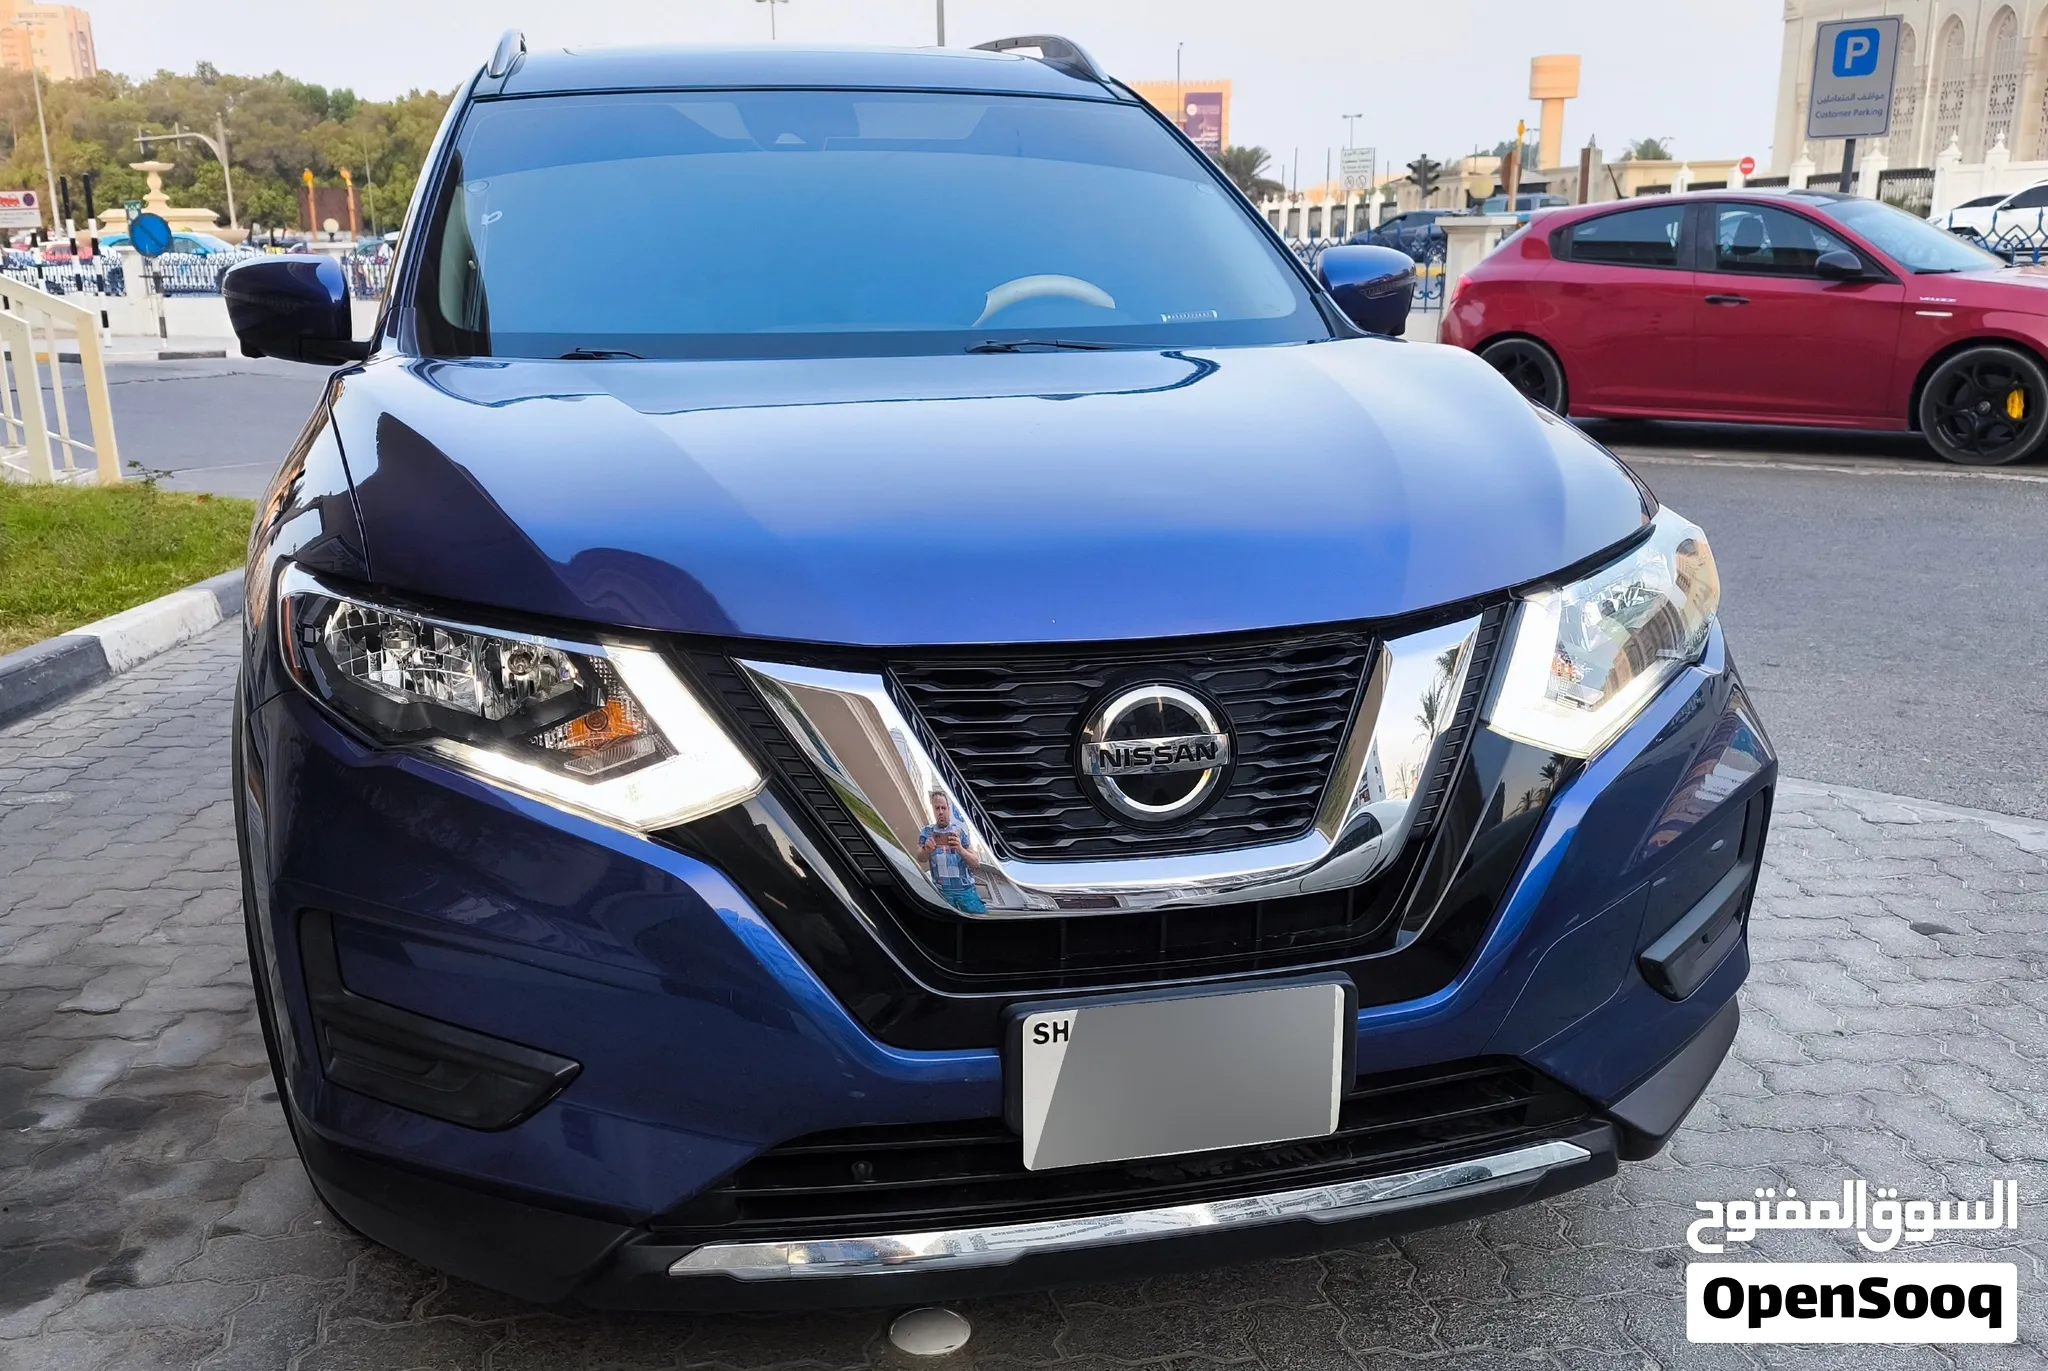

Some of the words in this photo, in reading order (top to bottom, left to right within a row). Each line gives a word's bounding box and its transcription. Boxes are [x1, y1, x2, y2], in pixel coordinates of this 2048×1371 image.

[1844, 36, 1871, 69] P
[1815, 110, 1852, 119] Customer
[1852, 108, 1884, 118] Parking
[1099, 741, 1217, 768] NISSAN
[1032, 1019, 1070, 1045] SH
